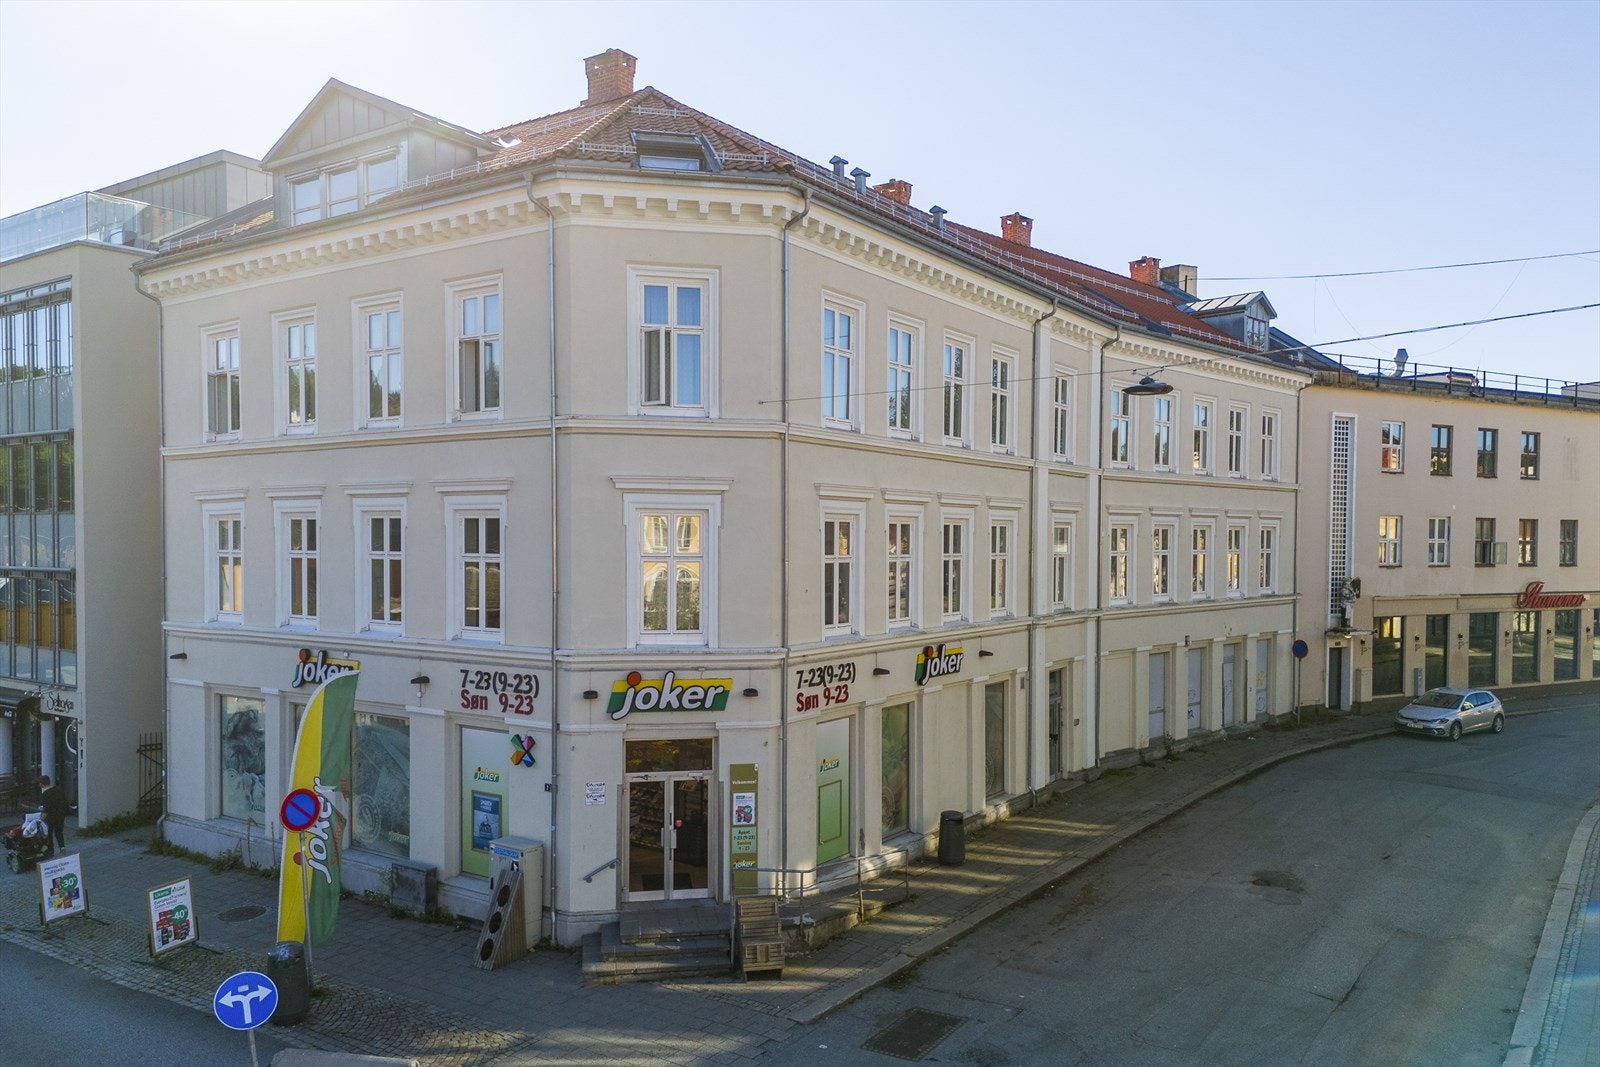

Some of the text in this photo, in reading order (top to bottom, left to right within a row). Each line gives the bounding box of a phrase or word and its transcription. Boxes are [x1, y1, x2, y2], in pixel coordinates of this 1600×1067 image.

[796, 662, 856, 689] 7-23(9-23)
[922, 644, 964, 686] joker
[460, 669, 540, 698] 7-23(9-23)
[611, 671, 725, 720] joker
[461, 689, 534, 715] Søn 9-23
[796, 684, 849, 712] Søn 9-23
[475, 767, 498, 781] joker
[818, 759, 839, 776] joker
